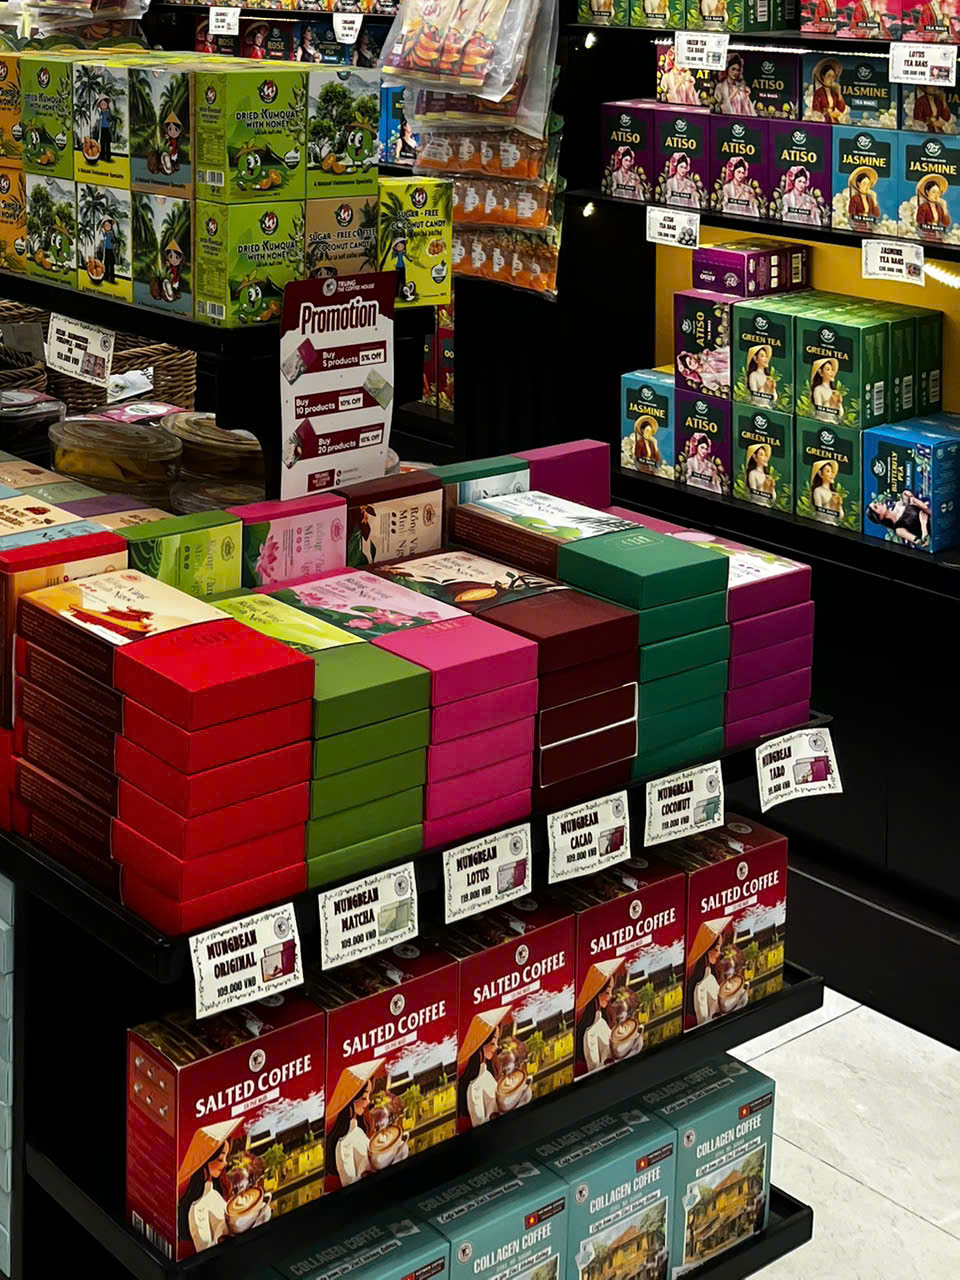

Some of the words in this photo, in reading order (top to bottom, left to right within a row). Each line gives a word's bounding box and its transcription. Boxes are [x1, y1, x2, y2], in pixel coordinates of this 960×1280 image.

[752, 78, 784, 91] ATISO
[842, 86, 888, 98] JASMINE
[236, 111, 258, 120] DRIED
[246, 121, 263, 129] WITH
[265, 120, 290, 129] HONEY
[611, 132, 640, 144] ATISO
[665, 137, 697, 150] ATISO
[722, 142, 755, 155] ATISO
[781, 150, 817, 163] ATISO
[842, 154, 887, 168] JASMINE
[909, 161, 957, 175] JASMINE
[424, 209, 439, 218] FREE
[425, 220, 446, 229] CANDY
[309, 232, 331, 241] SUGAR
[337, 231, 352, 240] FREE
[238, 245, 260, 254] DRIED
[247, 253, 265, 261] WITH
[266, 252, 290, 260] HONEY
[301, 298, 377, 335] Promotion
[696, 312, 705, 347] ATISO
[742, 333, 767, 344] GREEN
[767, 338, 782, 347] TEA
[323, 351, 336, 360] Buy
[323, 359, 328, 367] 5
[329, 355, 359, 367] products
[372, 351, 382, 360] Off
[806, 346, 833, 357] GREEN
[833, 352, 849, 361] TEA
[296, 399, 309, 407] Buy
[296, 406, 304, 414] 10
[304, 402, 336, 414] products
[352, 397, 362, 405] Off
[629, 402, 665, 419] JASMINE
[685, 417, 718, 433] ATISO
[318, 445, 327, 453] 20
[328, 440, 356, 452] products
[372, 433, 381, 441] Off
[319, 438, 331, 446] Buy
[741, 431, 766, 443] GREEN
[766, 437, 781, 447] TEA
[806, 447, 833, 459] GREEN
[833, 453, 849, 463] TEA
[769, 765, 786, 781] TARO
[658, 780, 694, 802] MUNGBEAN
[661, 798, 691, 816] COCONUT
[560, 811, 599, 835] MUNGBEAN
[570, 832, 593, 850] CACAO
[457, 846, 498, 872] MUNGBEAN
[466, 868, 490, 887] LOTUS
[701, 886, 741, 914] SALTED
[743, 870, 779, 898] COFFEE
[334, 887, 379, 916] MUNGBEAN
[341, 909, 375, 932] MATCHA
[590, 923, 634, 955] SALTED
[636, 907, 676, 939] COFFEE
[206, 930, 258, 961] MUNGBEAN
[341, 934, 367, 949] 109.000
[214, 952, 257, 980] ORIGINAL
[473, 969, 521, 1005] SALTED
[523, 951, 566, 982] COFFEE
[217, 981, 243, 998] 109.000
[244, 976, 257, 989] VND
[343, 1023, 396, 1058] SALTED
[397, 999, 447, 1032] COFFEE
[195, 1079, 255, 1118] SALTED
[258, 1054, 312, 1092] COFFEE
[697, 1129, 735, 1159] COLLAGEN
[736, 1114, 761, 1138] COFFEE
[589, 1181, 631, 1214] COLLAGEN
[633, 1166, 661, 1192] COFFEE
[474, 1238, 520, 1274] COLLAGEN
[522, 1222, 552, 1250] COFFEE
